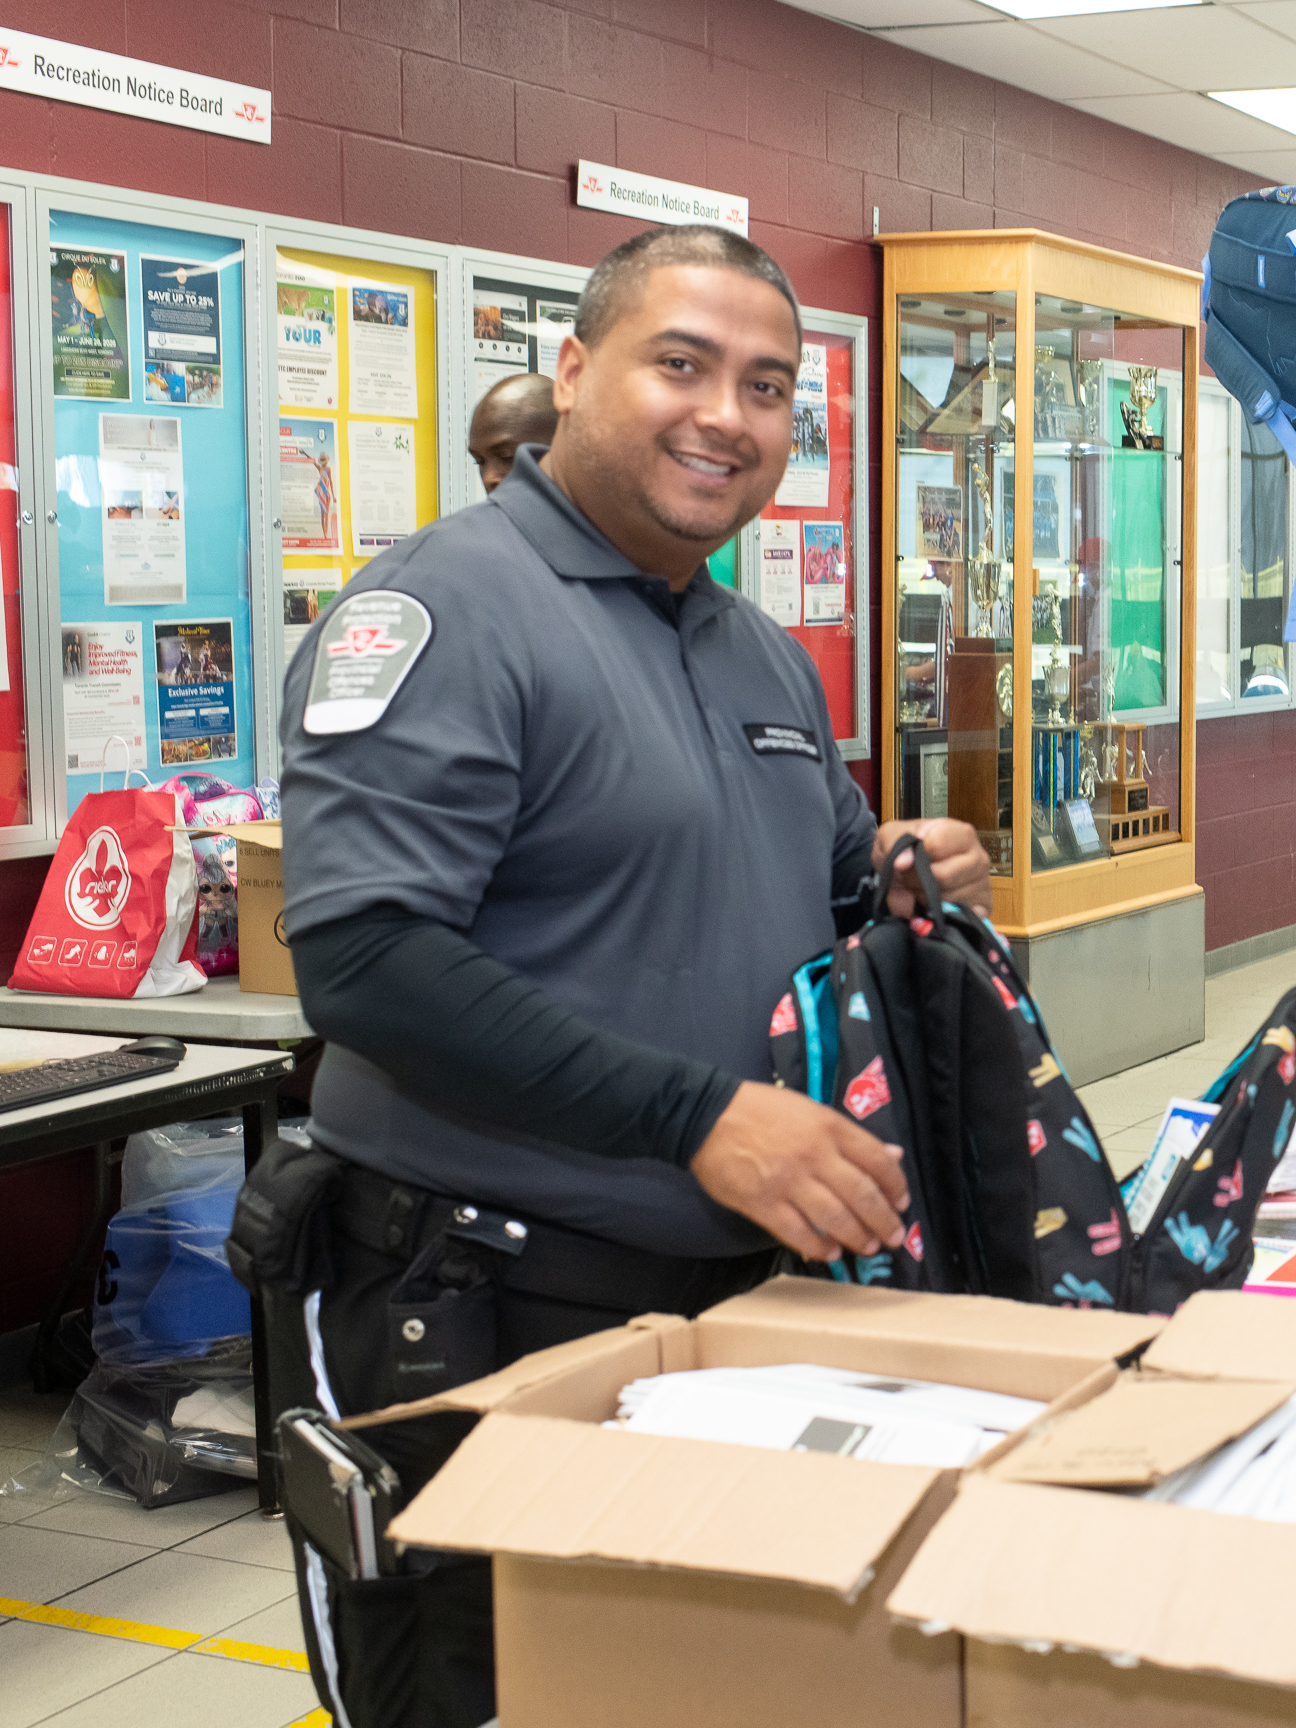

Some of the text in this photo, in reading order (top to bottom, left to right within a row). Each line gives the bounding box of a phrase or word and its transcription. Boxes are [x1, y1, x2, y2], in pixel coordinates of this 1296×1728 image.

[34, 54, 223, 116] Recreation Notice Board
[610, 181, 720, 220] Recreation Notice Board
[61, 252, 107, 265] CIRQUE DU SOLEIL
[147, 290, 170, 301] SAVE
[172, 293, 184, 304] UP
[185, 294, 196, 305] TO
[198, 295, 214, 307] 25%
[57, 335, 70, 344] MAY
[79, 337, 93, 346] JUNE
[284, 325, 322, 345] YOUR
[307, 367, 327, 376] DISCOUNT
[342, 613, 402, 625] Protection
[88, 642, 104, 652] Enjoy
[88, 649, 116, 660] Improved
[89, 658, 128, 667] Mental Health
[89, 666, 132, 676] and Well-Being
[168, 685, 225, 698] Exclusive Savings
[244, 848, 259, 856] SELL
[261, 848, 280, 857] UNITS
[240, 878, 252, 887] CW
[253, 878, 275, 889] BLUEY
